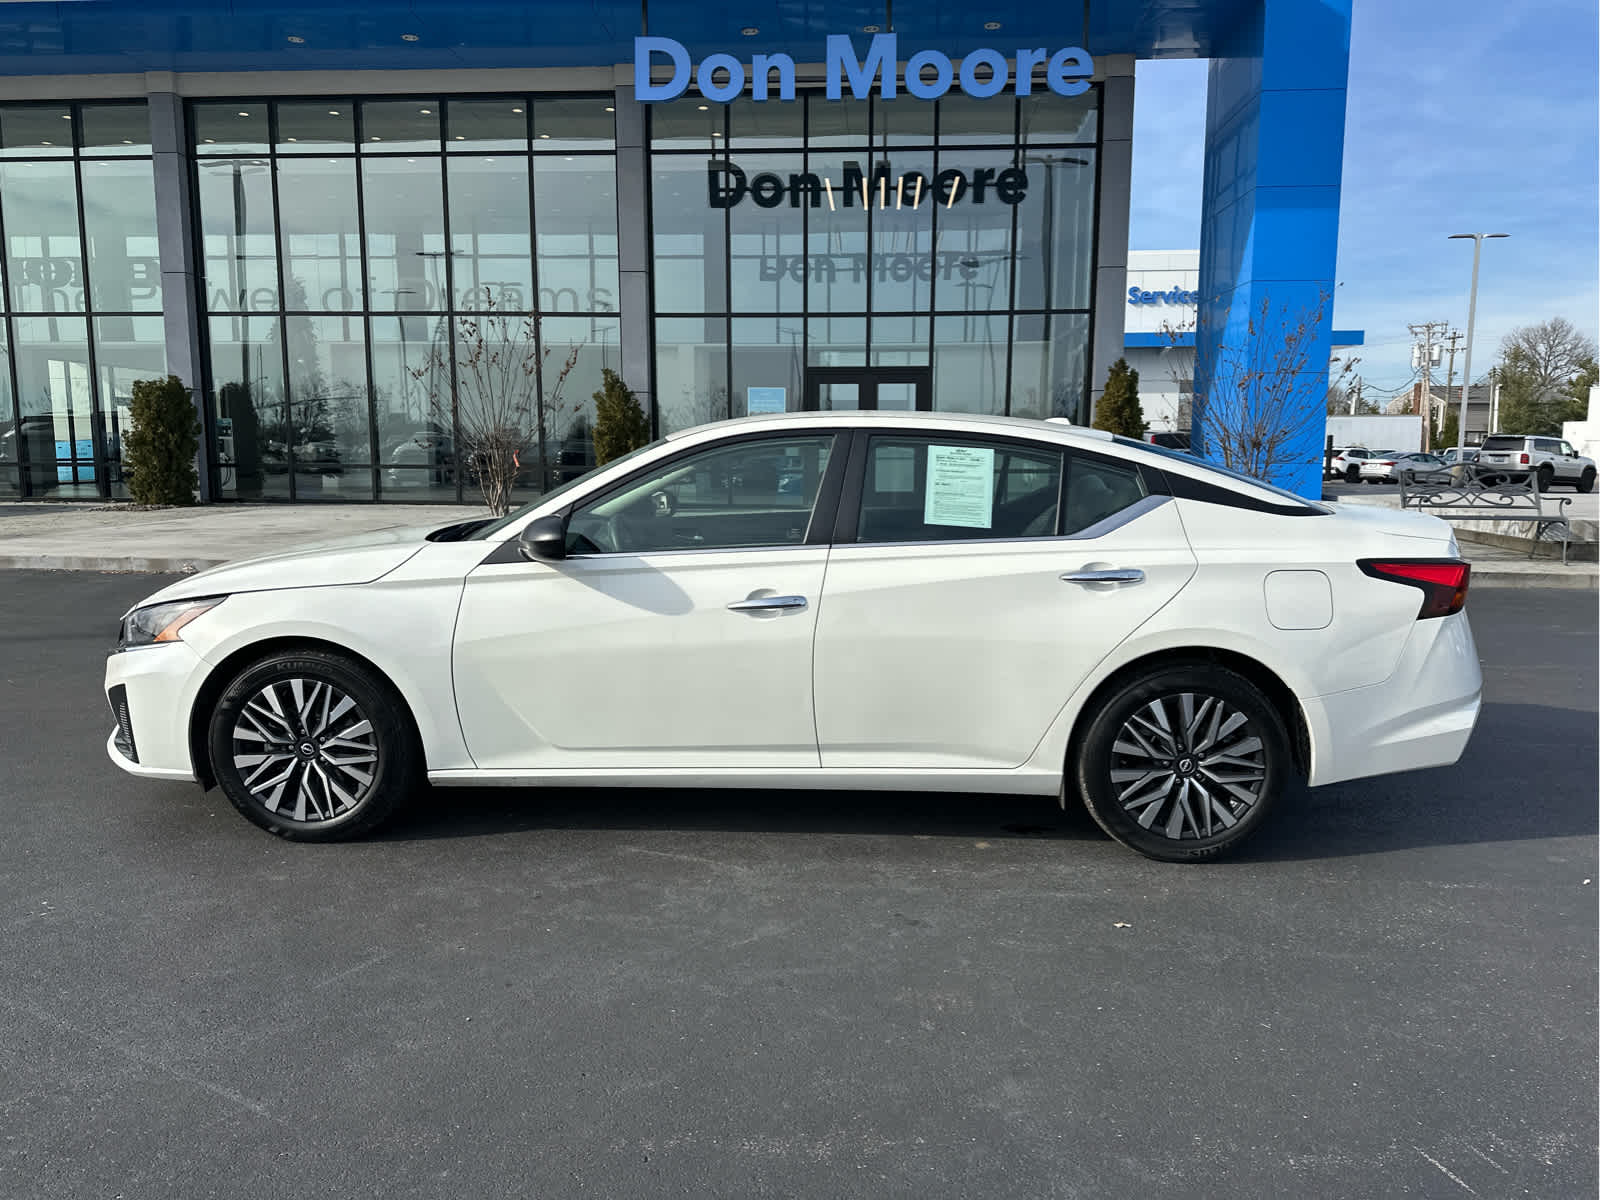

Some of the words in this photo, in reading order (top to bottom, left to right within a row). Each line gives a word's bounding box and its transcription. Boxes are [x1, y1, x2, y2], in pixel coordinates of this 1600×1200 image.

[635, 36, 796, 102] Don
[826, 33, 1095, 100] Moore
[708, 160, 821, 208] Don
[842, 160, 1028, 206] Moore
[759, 255, 836, 283] Don
[853, 253, 979, 283] Moore
[1128, 285, 1199, 305] Service
